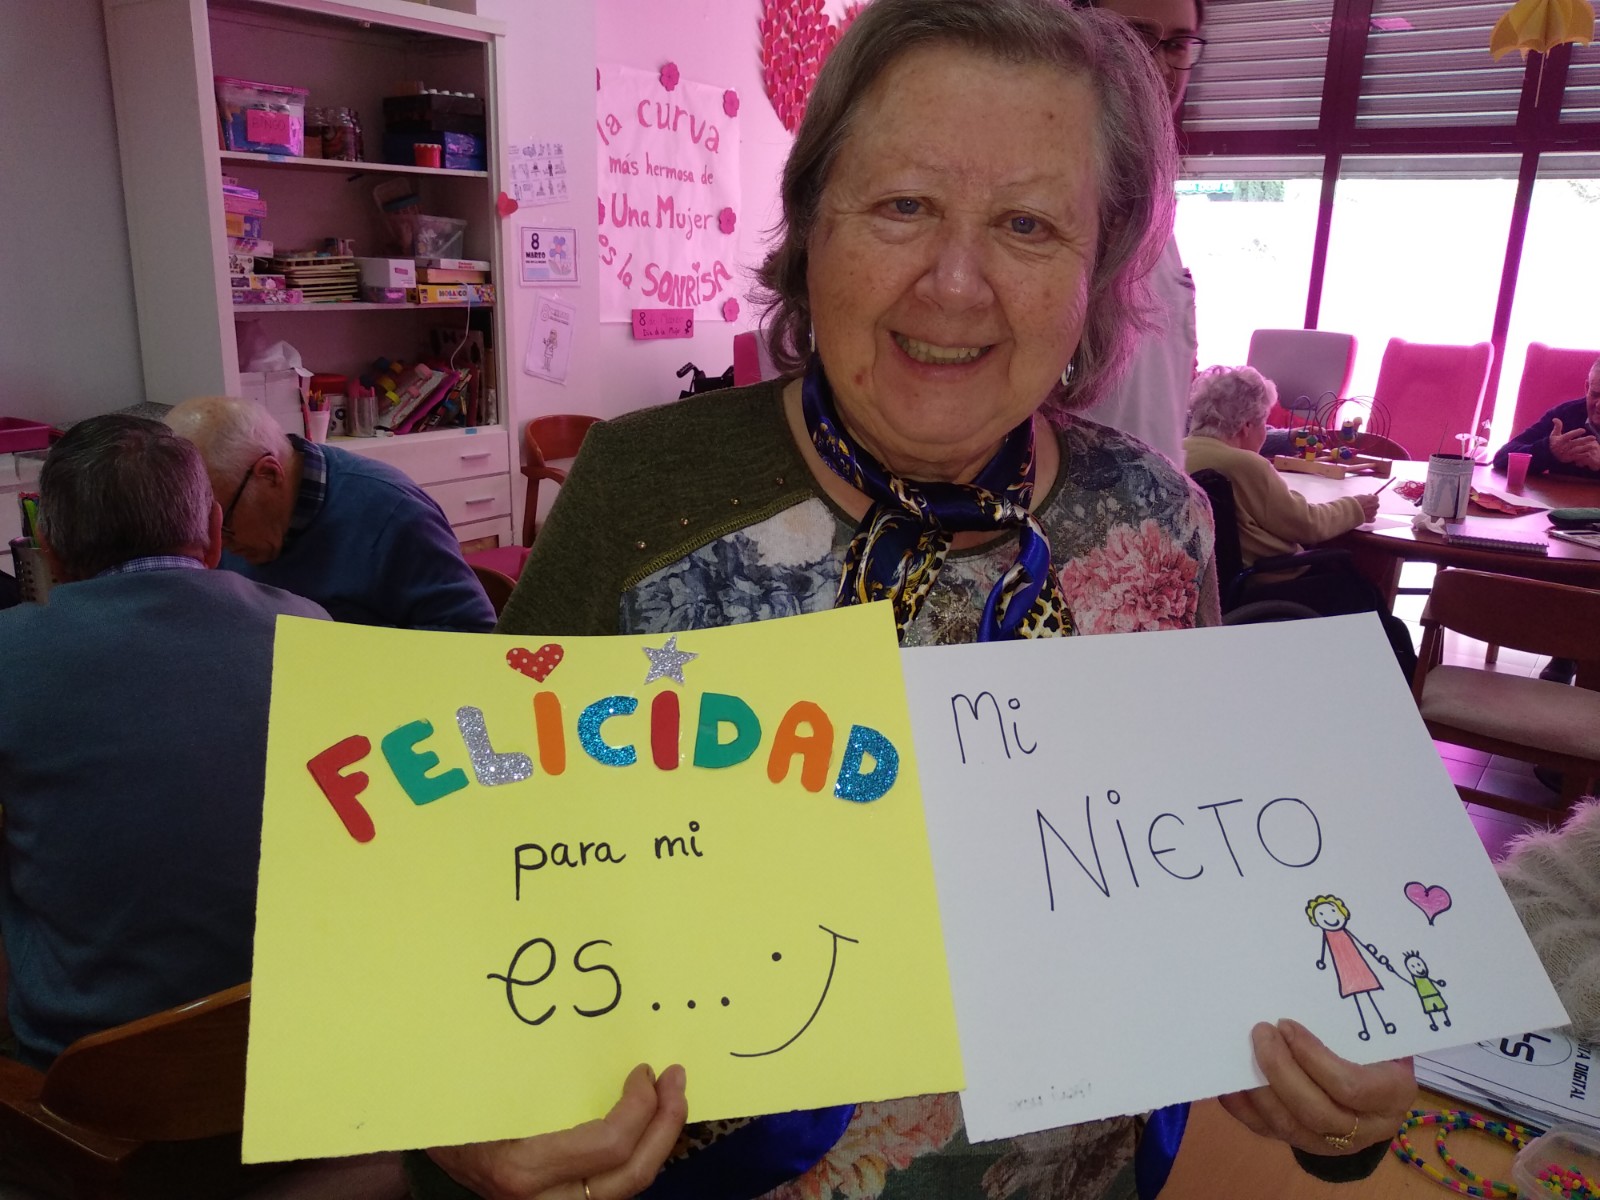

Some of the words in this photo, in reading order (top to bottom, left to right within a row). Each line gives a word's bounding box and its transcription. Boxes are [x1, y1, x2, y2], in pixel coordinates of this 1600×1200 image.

[597, 113, 623, 146] la
[637, 98, 720, 154] curva
[608, 152, 639, 176] más
[645, 151, 695, 183] hermosa
[700, 164, 714, 185] de
[611, 192, 651, 228] Una
[656, 194, 714, 241] Mujer
[531, 233, 540, 250] 8
[639, 311, 647, 326] 8
[951, 691, 1037, 765] Mi
[306, 690, 900, 844] FELICIDAD
[514, 841, 627, 901] para
[654, 820, 703, 859] mi
[1569, 1061, 1590, 1101] DIGITAL
